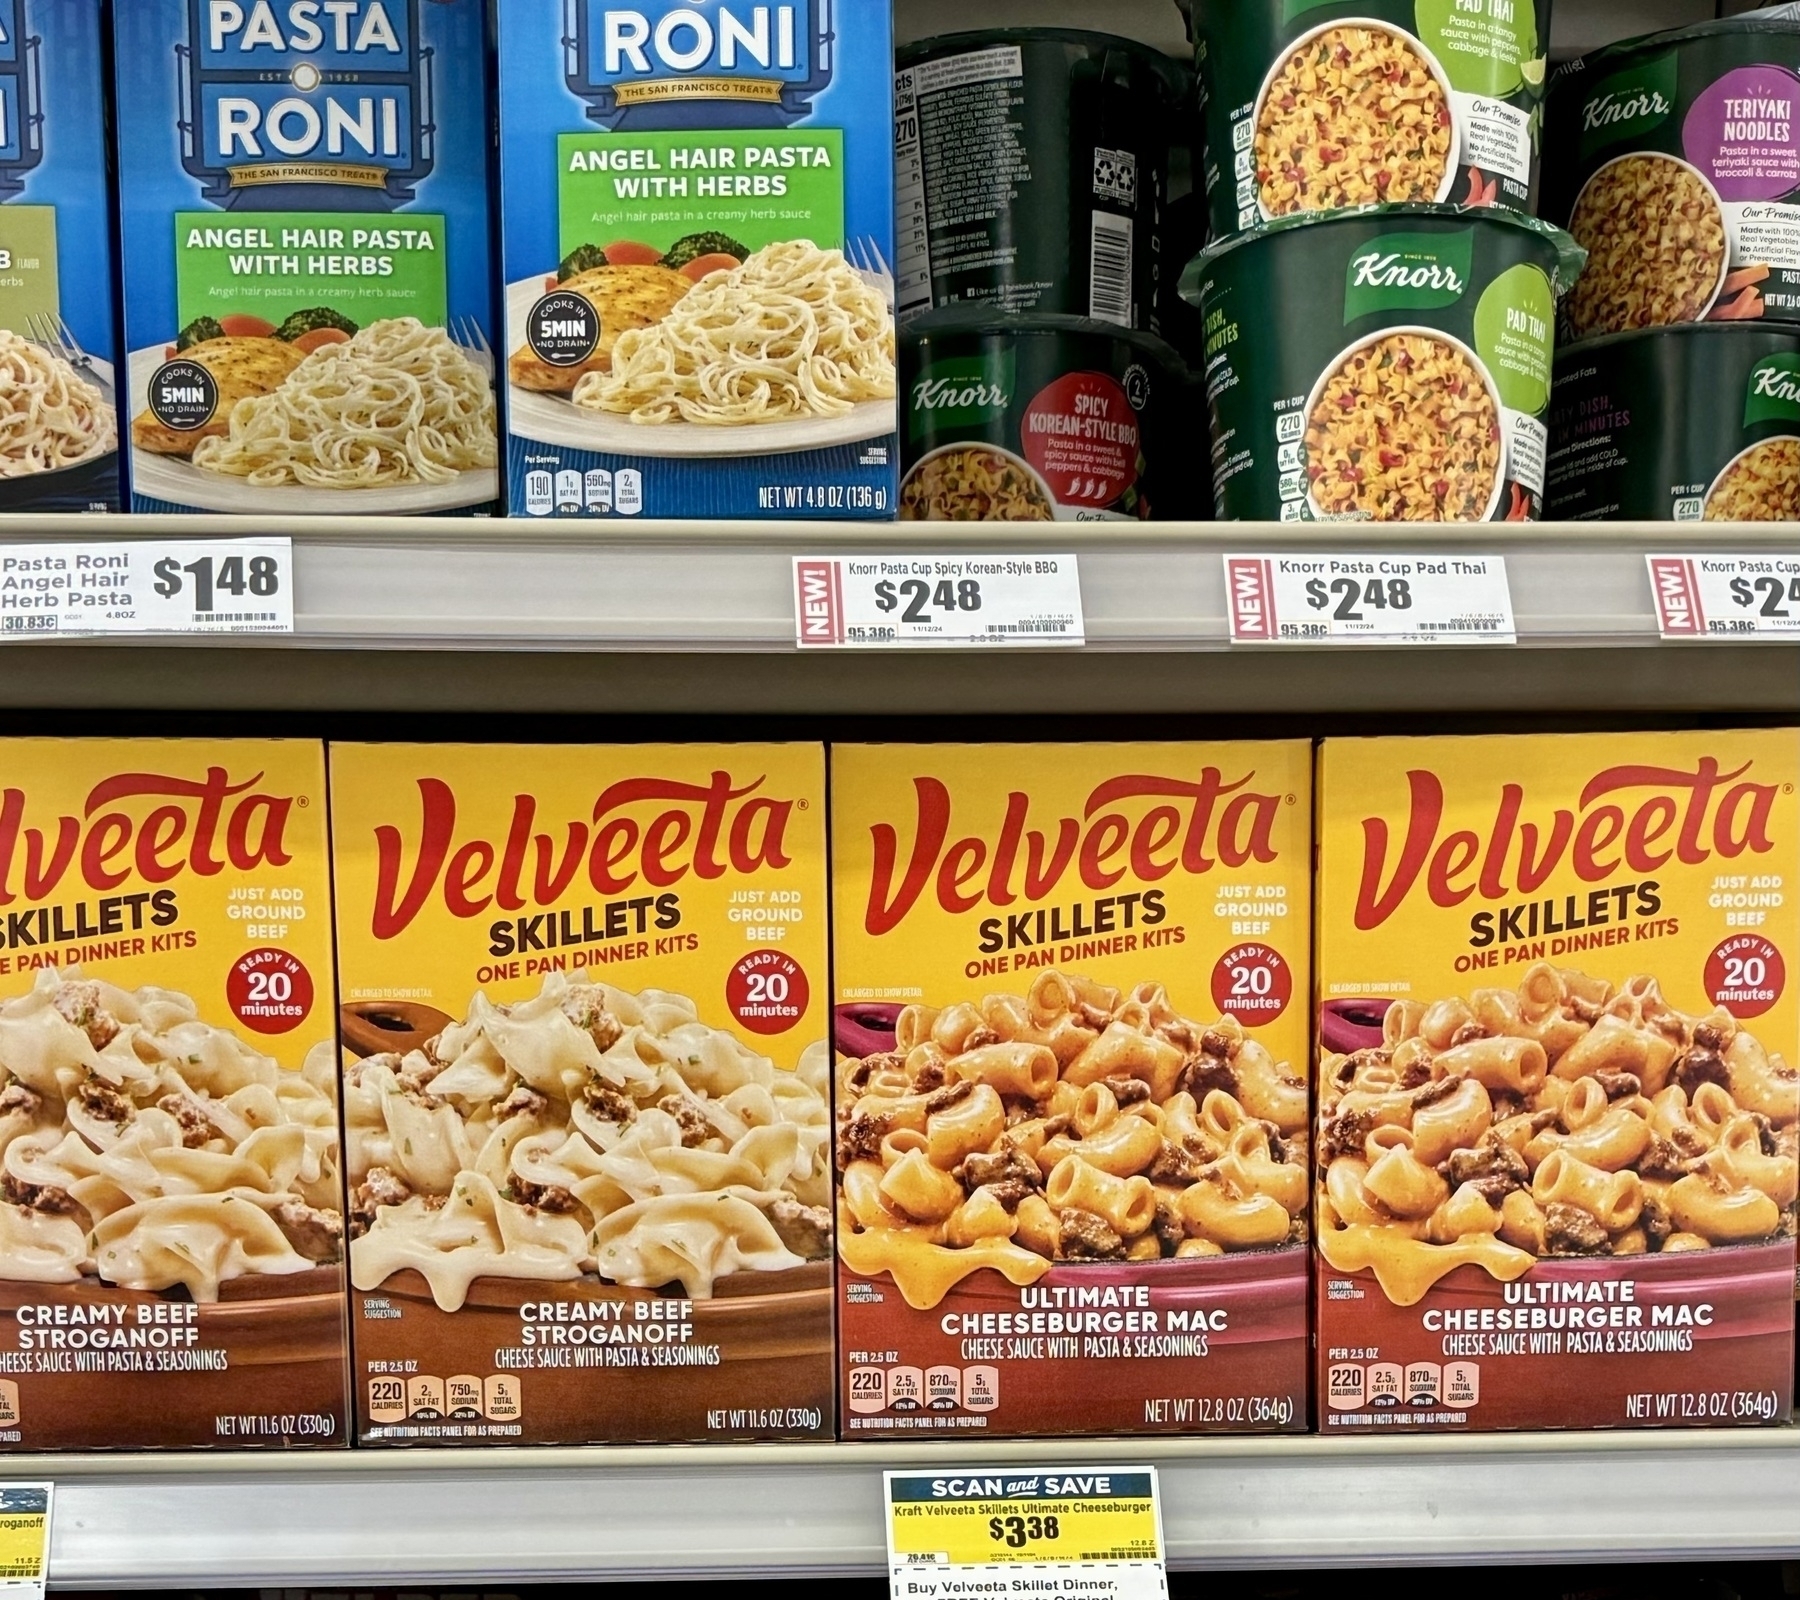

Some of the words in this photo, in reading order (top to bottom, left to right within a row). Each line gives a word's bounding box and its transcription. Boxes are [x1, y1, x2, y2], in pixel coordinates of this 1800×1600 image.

[209, 1, 400, 53] PASTA
[605, 6, 795, 72] RONI
[625, 89, 645, 97] THE
[648, 86, 668, 94] SAN
[672, 84, 730, 93] FRANCISCO
[1582, 92, 1667, 131] Knorr
[1724, 99, 1791, 120] TERIYAKI
[219, 97, 401, 156] RONI
[1724, 121, 1790, 142] NOODLES
[1720, 147, 1748, 155] Pasta
[1751, 147, 1759, 155] in
[1770, 148, 1797, 156] sweet
[1712, 158, 1750, 167] teriyaki
[1781, 159, 1799, 167] with
[1715, 169, 1753, 177] broccoli
[1757, 169, 1764, 177] &
[591, 212, 623, 225] Angel
[626, 211, 648, 222] hair
[650, 213, 680, 224] pasta
[684, 211, 694, 220] in
[706, 212, 747, 223] creamy
[751, 209, 776, 219] herb
[779, 211, 811, 219] sauce
[187, 229, 273, 248] ANGEL
[282, 229, 344, 249] HAIR
[353, 230, 434, 250] PASTA
[229, 255, 299, 274] WITH
[308, 256, 393, 276] HERBS
[1353, 253, 1458, 294] Knorr
[1507, 308, 1526, 332] PAD
[1529, 316, 1546, 342] THAI
[161, 388, 204, 403] 5MIN
[913, 378, 1005, 410] Knorr
[1075, 394, 1109, 416] SPICY
[1029, 413, 1116, 442] KOREAN-STYLE
[1119, 424, 1137, 447] BBQ
[1281, 415, 1300, 432] 270
[759, 487, 781, 508] NET
[784, 487, 803, 508] WT
[807, 488, 824, 508] 4.8
[828, 488, 843, 508] OZ
[3, 556, 67, 572] Pasta
[76, 553, 129, 570] Roni
[849, 563, 876, 575] Knorr
[881, 563, 908, 575] Pasta
[912, 562, 932, 577] Cup
[935, 562, 963, 577] Spicy
[966, 561, 1032, 576] Korean-Style
[1035, 562, 1058, 575] BBQ
[2, 574, 72, 592] Angel
[81, 573, 129, 588] Hair
[153, 556, 279, 611] $148
[0, 593, 58, 608] Herb
[68, 591, 133, 608] Pasta
[803, 569, 830, 636] NEW!
[874, 579, 982, 623] $248
[865, 767, 1281, 936] Velveeta
[1355, 757, 1779, 930] Velveeta
[728, 892, 762, 904] JUST
[769, 891, 801, 903] ADD
[727, 908, 803, 923] GROUND
[978, 890, 1166, 953] SKILLETS
[746, 926, 786, 941] BEEF
[965, 956, 1009, 979] ONE
[1013, 948, 1055, 972] PAN
[1061, 935, 1137, 966] DINNER
[1142, 926, 1186, 950] KITS
[746, 974, 788, 1002] 20
[740, 1004, 798, 1018] minutes
[1504, 1281, 1634, 1304] ULTIMATE
[16, 1305, 127, 1326] CREAMY
[138, 1304, 200, 1325] BEEF
[1422, 1304, 1642, 1332] CHEESEBURGER
[1652, 1304, 1714, 1327] MAC
[19, 1328, 200, 1349] STROGANOFF
[1331, 1369, 1361, 1386] 220
[932, 1480, 1003, 1496] SCAN
[1006, 1477, 1039, 1497] and
[1045, 1477, 1111, 1495] SAVE
[895, 1505, 923, 1516] Kraft
[925, 1505, 975, 1515] Velveeta
[978, 1504, 1019, 1515] Skillets
[1022, 1503, 1069, 1514] Ultimate
[1073, 1503, 1151, 1516] Cheeseburger
[989, 1516, 1059, 1548] $338
[908, 1582, 937, 1596] Buy
[941, 1581, 1007, 1593] Velveeta
[1012, 1580, 1058, 1592] Skillet
[1063, 1579, 1118, 1592] Dinner,
